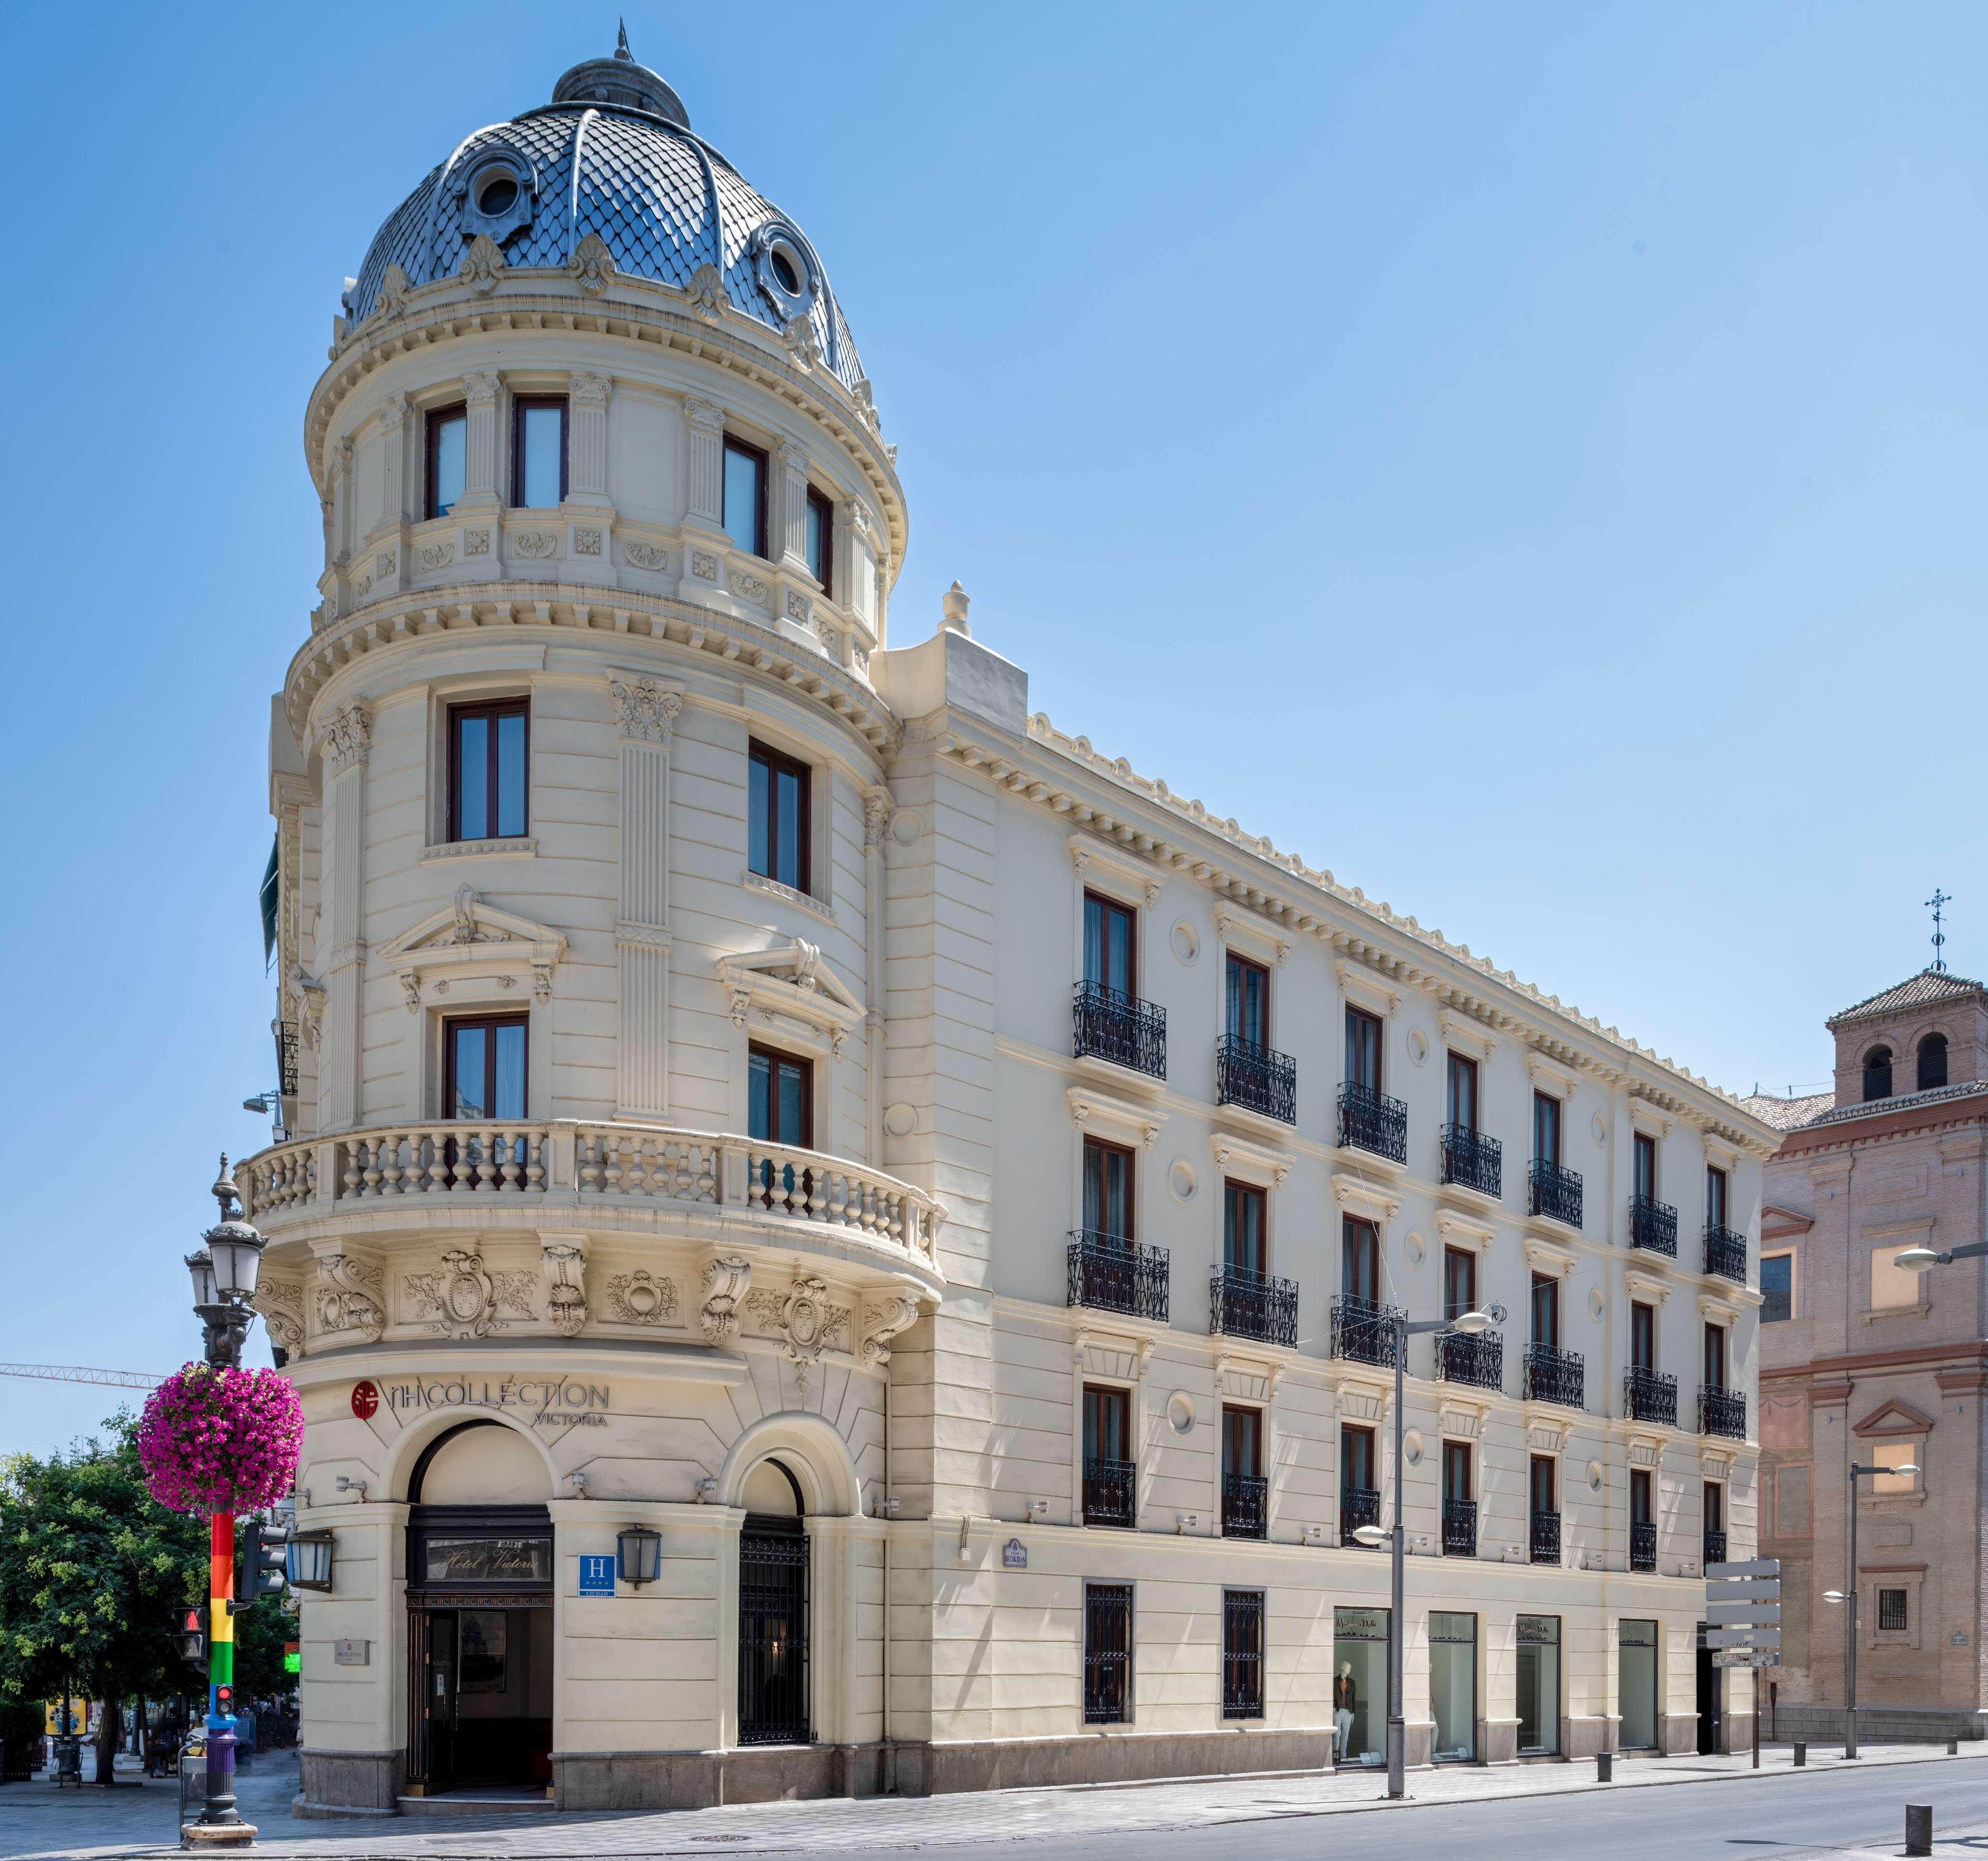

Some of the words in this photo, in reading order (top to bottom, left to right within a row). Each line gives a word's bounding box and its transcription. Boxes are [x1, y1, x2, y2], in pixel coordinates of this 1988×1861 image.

[427, 1382, 608, 1409] COLLECTION
[534, 1411, 608, 1427] VICTORIA
[439, 1548, 488, 1570] Hotel
[492, 1548, 539, 1570] Victoria
[589, 1558, 605, 1578] H
